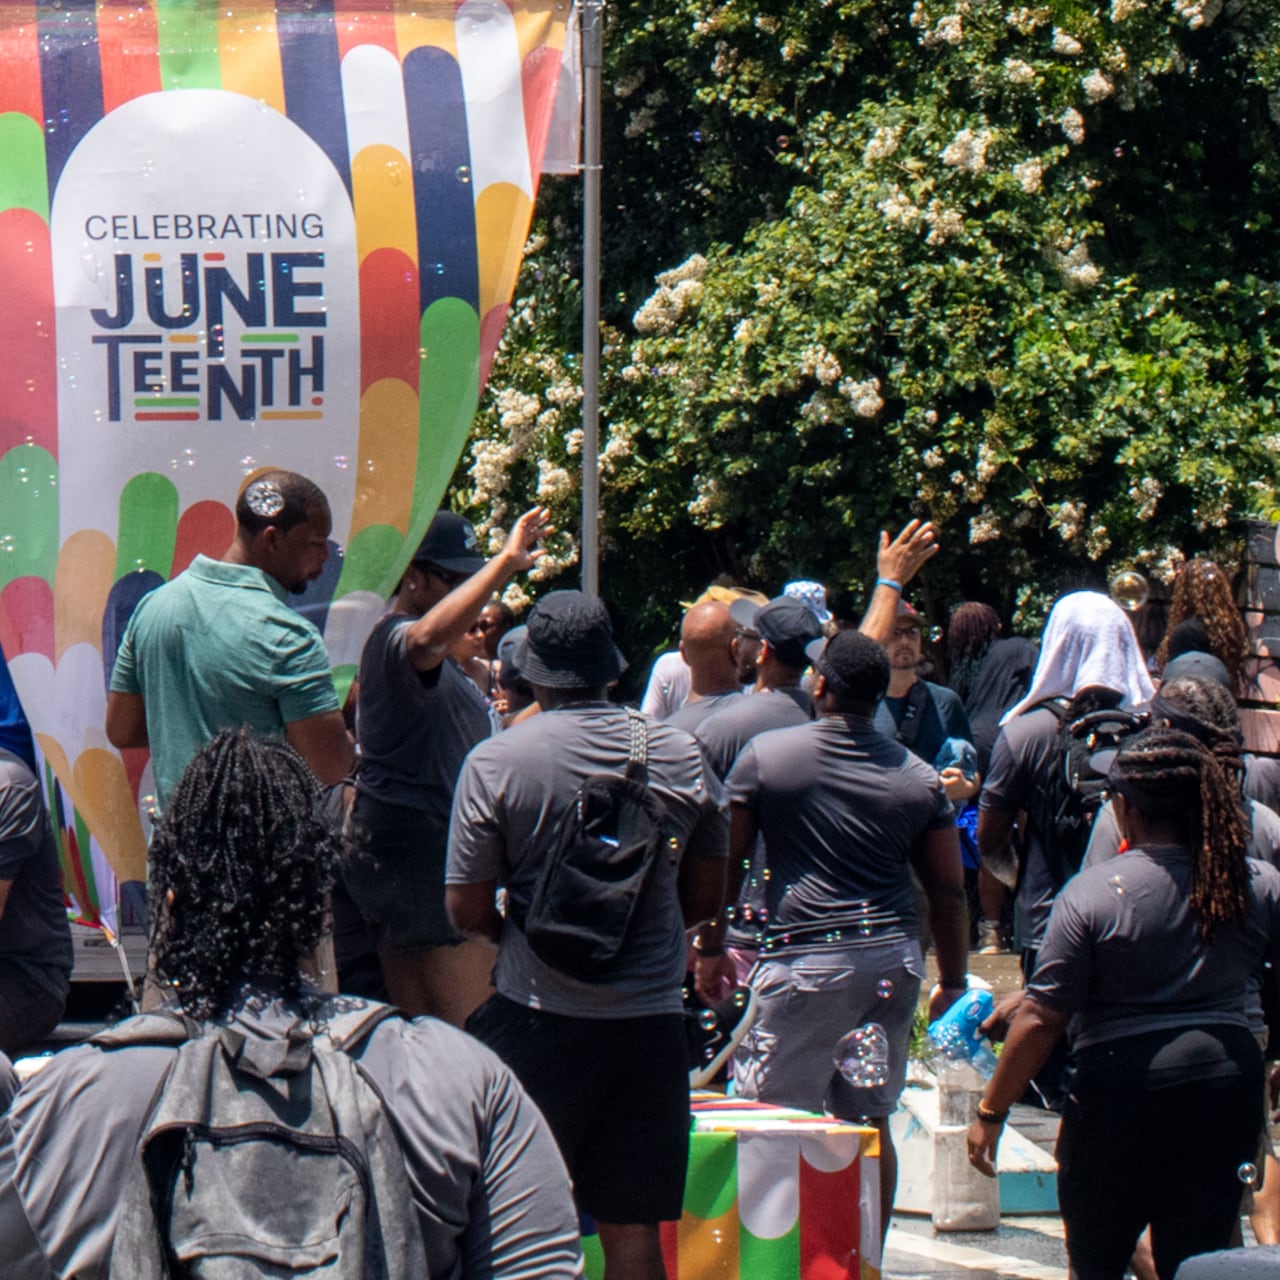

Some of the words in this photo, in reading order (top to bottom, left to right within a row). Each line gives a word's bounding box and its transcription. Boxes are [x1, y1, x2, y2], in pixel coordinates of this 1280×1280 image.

[84, 213, 325, 241] CELEBRATING
[90, 251, 328, 358] JUNE
[91, 334, 325, 422] TEENTH
